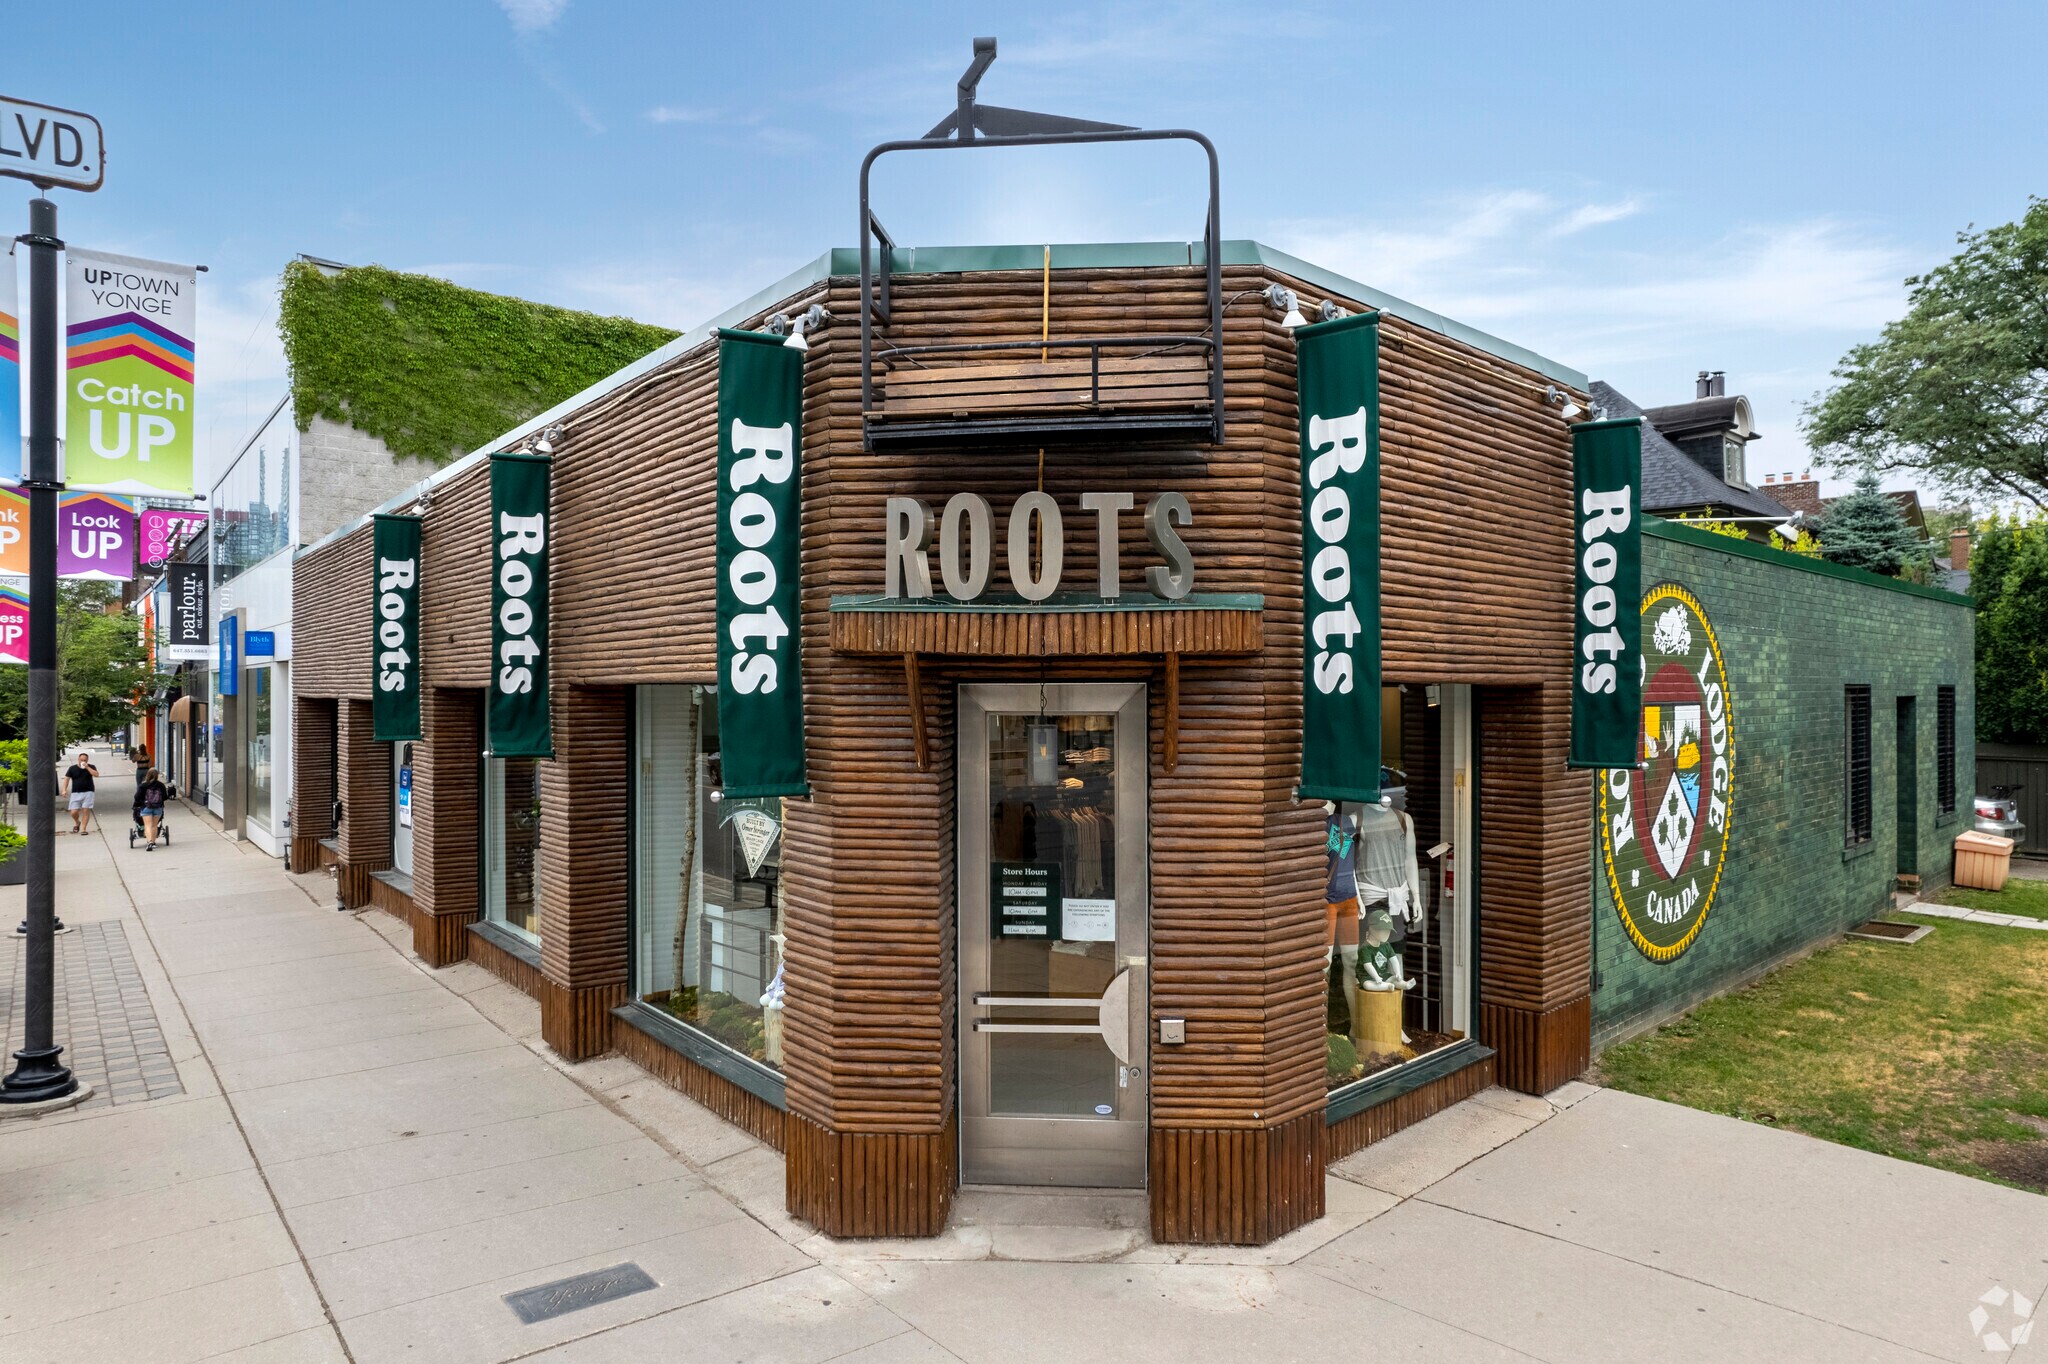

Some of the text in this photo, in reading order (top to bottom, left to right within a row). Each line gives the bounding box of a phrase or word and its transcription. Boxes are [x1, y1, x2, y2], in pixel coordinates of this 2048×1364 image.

[84, 267, 179, 297] UPTOWN
[91, 289, 172, 316] YONGE
[77, 378, 185, 412] Catch
[89, 408, 176, 463] UP
[71, 530, 123, 560] UP
[72, 512, 121, 529] Look
[885, 491, 1194, 600] ROOTS
[1309, 406, 1367, 694] Roots
[730, 418, 793, 695] Roots
[177, 572, 199, 640] parlour.
[500, 511, 544, 694] Roots
[1582, 485, 1631, 694] Roots
[250, 636, 270, 644] Blyth
[379, 557, 415, 692] Roots
[1697, 646, 1729, 834] LODGE
[1647, 877, 1700, 924] CANADA
